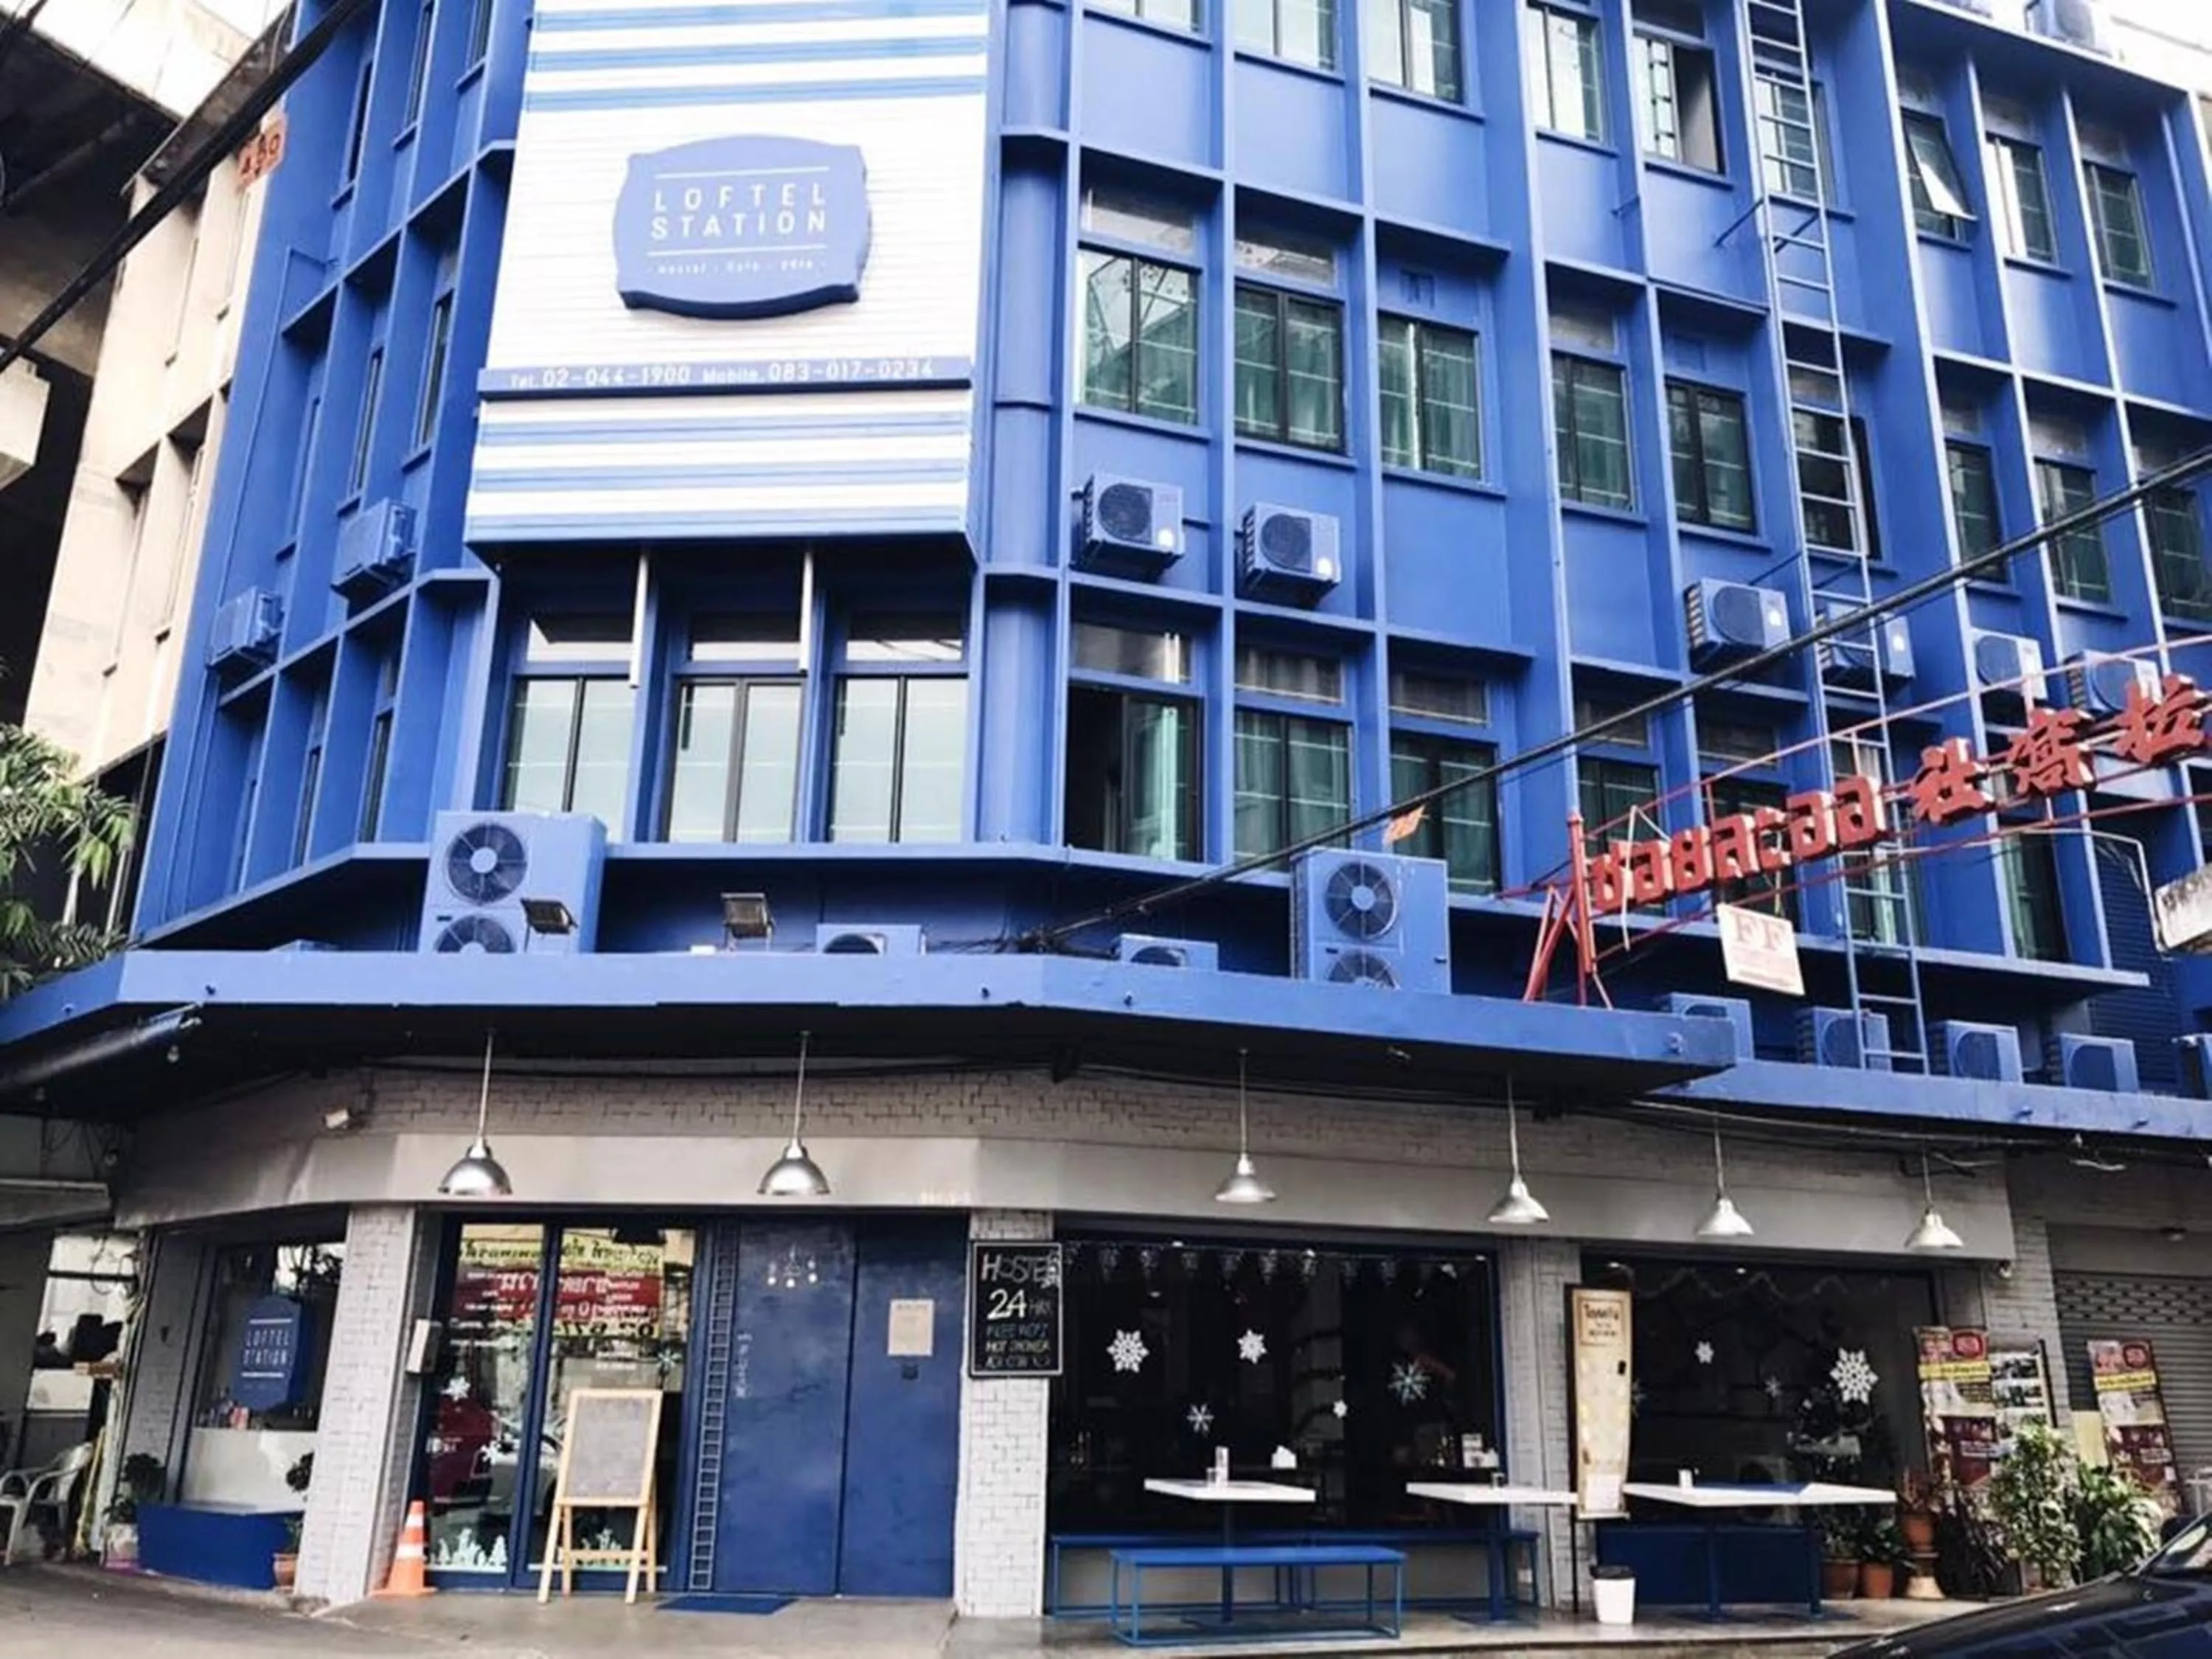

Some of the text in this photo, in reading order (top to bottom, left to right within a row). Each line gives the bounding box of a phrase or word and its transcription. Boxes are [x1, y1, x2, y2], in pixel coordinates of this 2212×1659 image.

[654, 182, 827, 212] LOFTEL
[651, 210, 826, 240] STATION
[981, 1252, 1060, 1284] HOSTE
[986, 1288, 1028, 1320] 24
